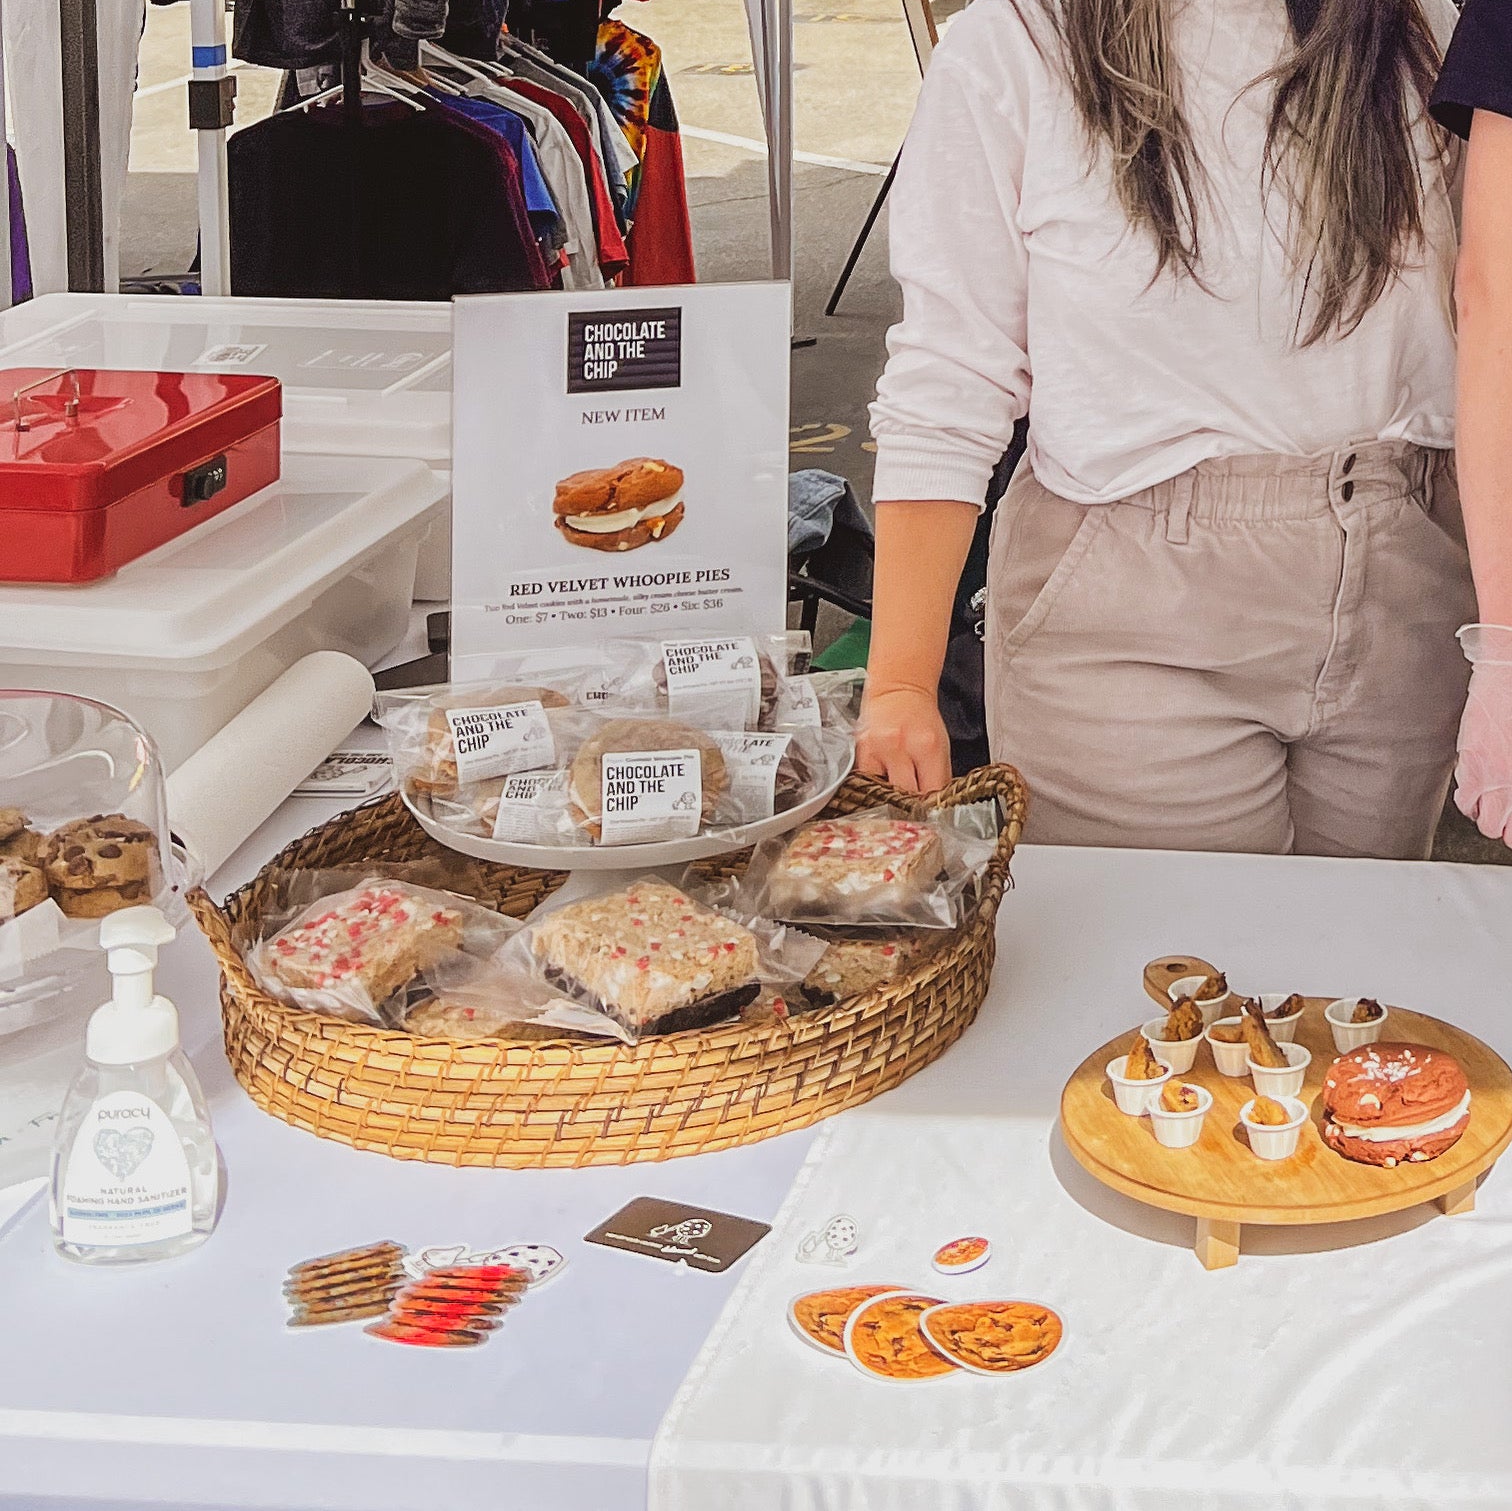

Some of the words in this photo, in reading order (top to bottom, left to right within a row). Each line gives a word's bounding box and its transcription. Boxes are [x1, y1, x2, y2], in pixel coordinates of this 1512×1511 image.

[584, 320, 666, 342] CHOCOLATE
[584, 342, 615, 361] AND
[617, 340, 646, 359] THE
[584, 360, 618, 380] CHIP
[581, 409, 621, 425] NEW
[625, 407, 666, 422] ITEM
[510, 583, 543, 597] RED
[547, 577, 609, 594] VELVET
[613, 571, 692, 588] WHOOPIE
[695, 568, 731, 583] PIES
[505, 614, 534, 625] One:
[535, 612, 548, 623] $7
[559, 610, 586, 621] Two:
[590, 607, 608, 619] $13
[650, 602, 671, 614] $26
[703, 598, 724, 610] $36
[665, 642, 739, 657] CHOCOLATE
[668, 656, 694, 666] AND
[699, 652, 722, 662] THE
[669, 663, 699, 675] CHIP
[452, 709, 529, 727] CHOCOLATE
[456, 723, 484, 738] AND
[489, 718, 514, 732] THE
[458, 734, 490, 754] CHIP
[606, 763, 685, 780] CHOCOLATE
[606, 781, 635, 796] AND
[639, 779, 665, 793] THE
[606, 795, 639, 812] CHIP
[97, 1106, 151, 1123] puracy
[100, 1186, 147, 1195] NATURAL
[107, 1197, 135, 1205] HAND
[138, 1187, 188, 1203] SANITIZER
